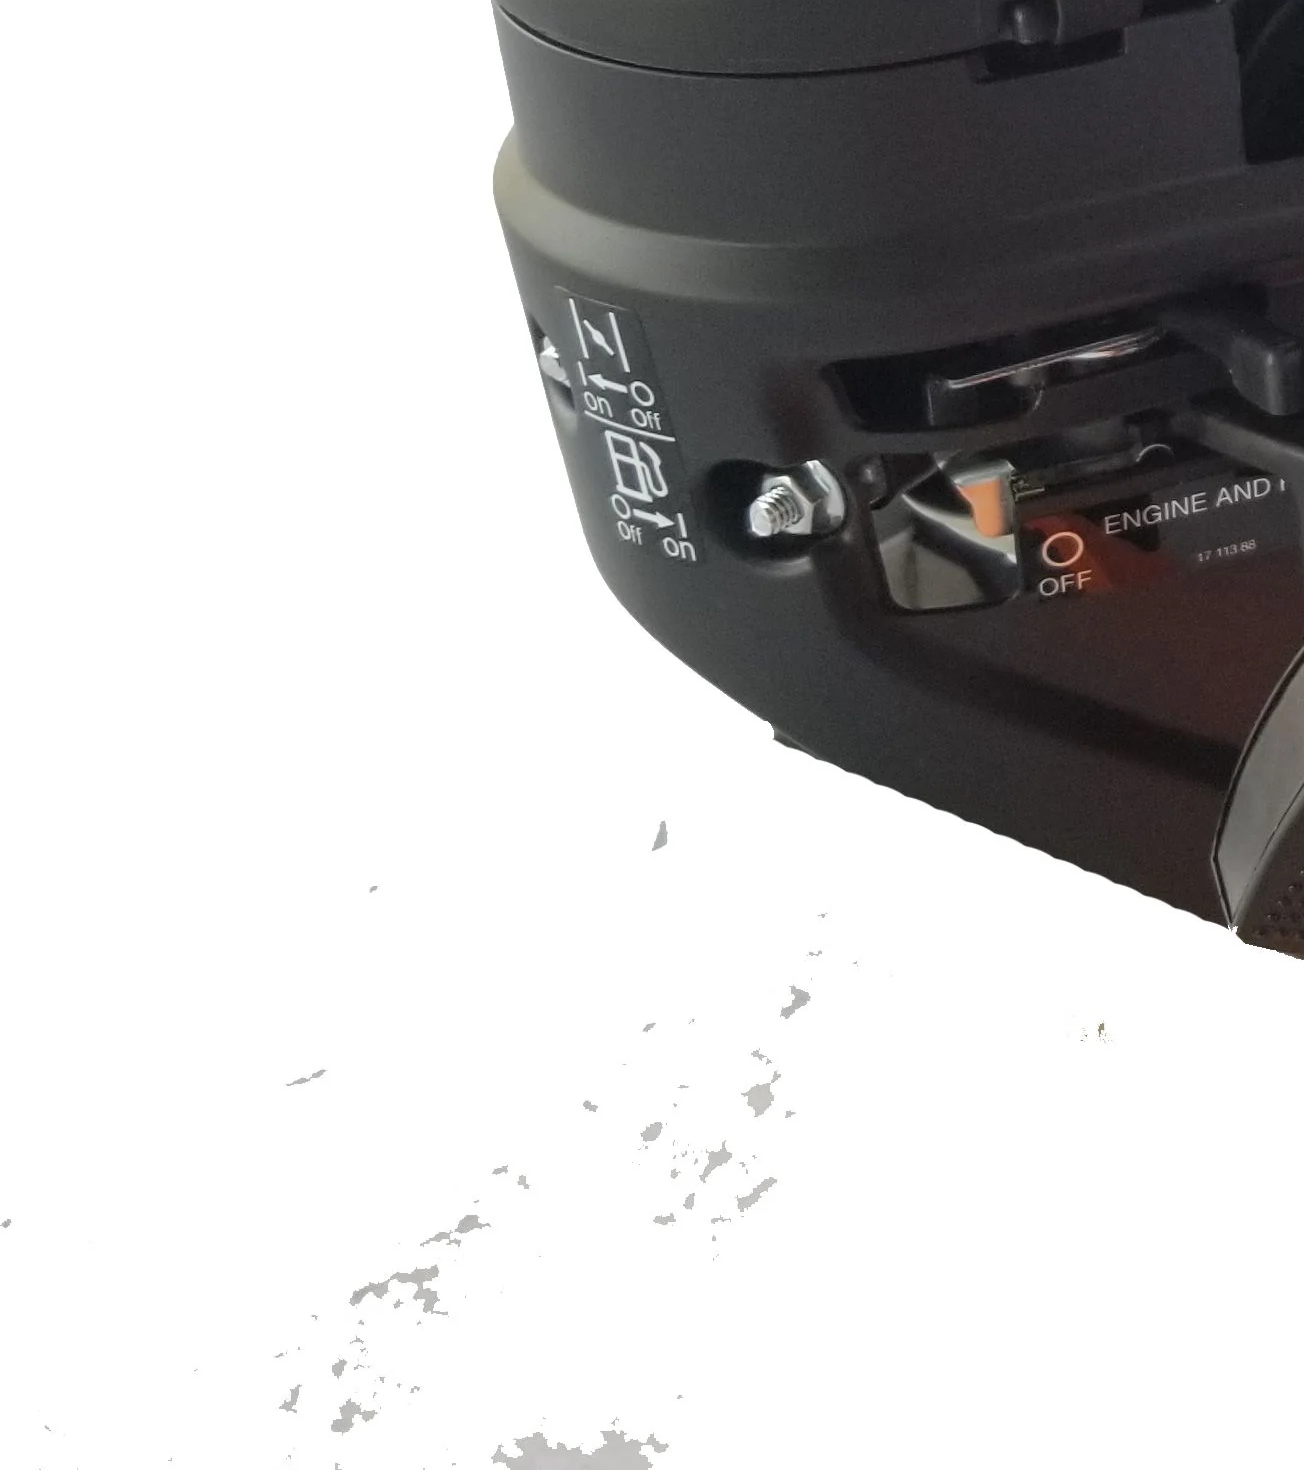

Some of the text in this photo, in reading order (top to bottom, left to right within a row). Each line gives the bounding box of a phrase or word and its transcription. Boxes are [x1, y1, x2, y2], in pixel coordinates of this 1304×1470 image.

[1104, 477, 1270, 534] ENGINE AND
[1039, 569, 1093, 596] OFF
